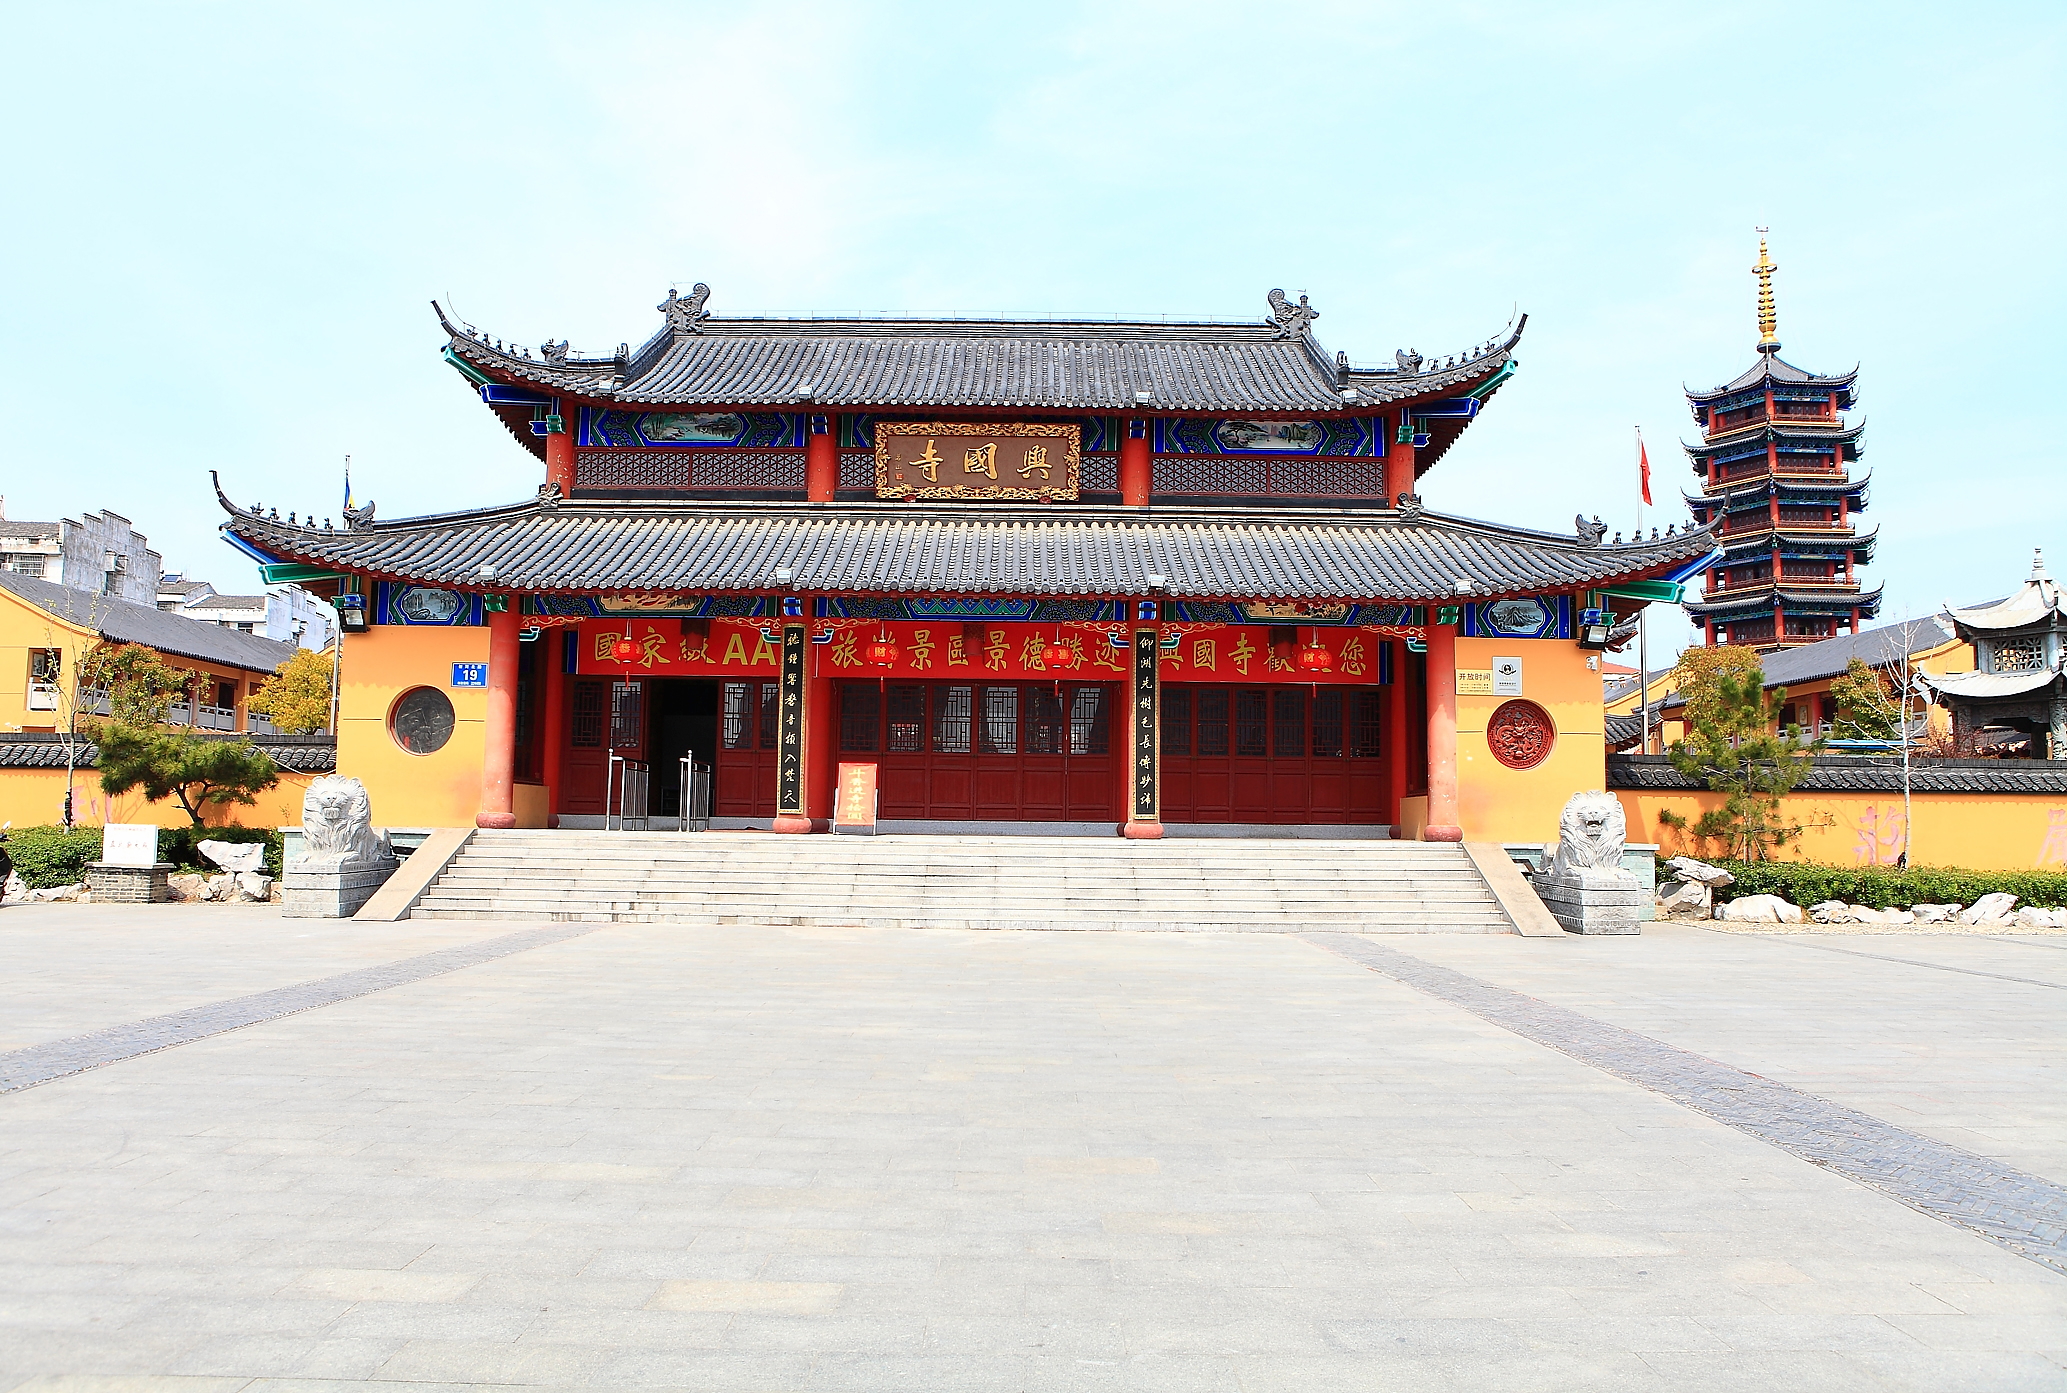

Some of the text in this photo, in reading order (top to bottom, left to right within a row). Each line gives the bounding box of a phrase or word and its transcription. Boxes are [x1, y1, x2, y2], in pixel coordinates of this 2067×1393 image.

[594, 625, 780, 669] 國家級AA
[462, 669, 478, 681] 19
[1459, 673, 1491, 681] 开放时间
